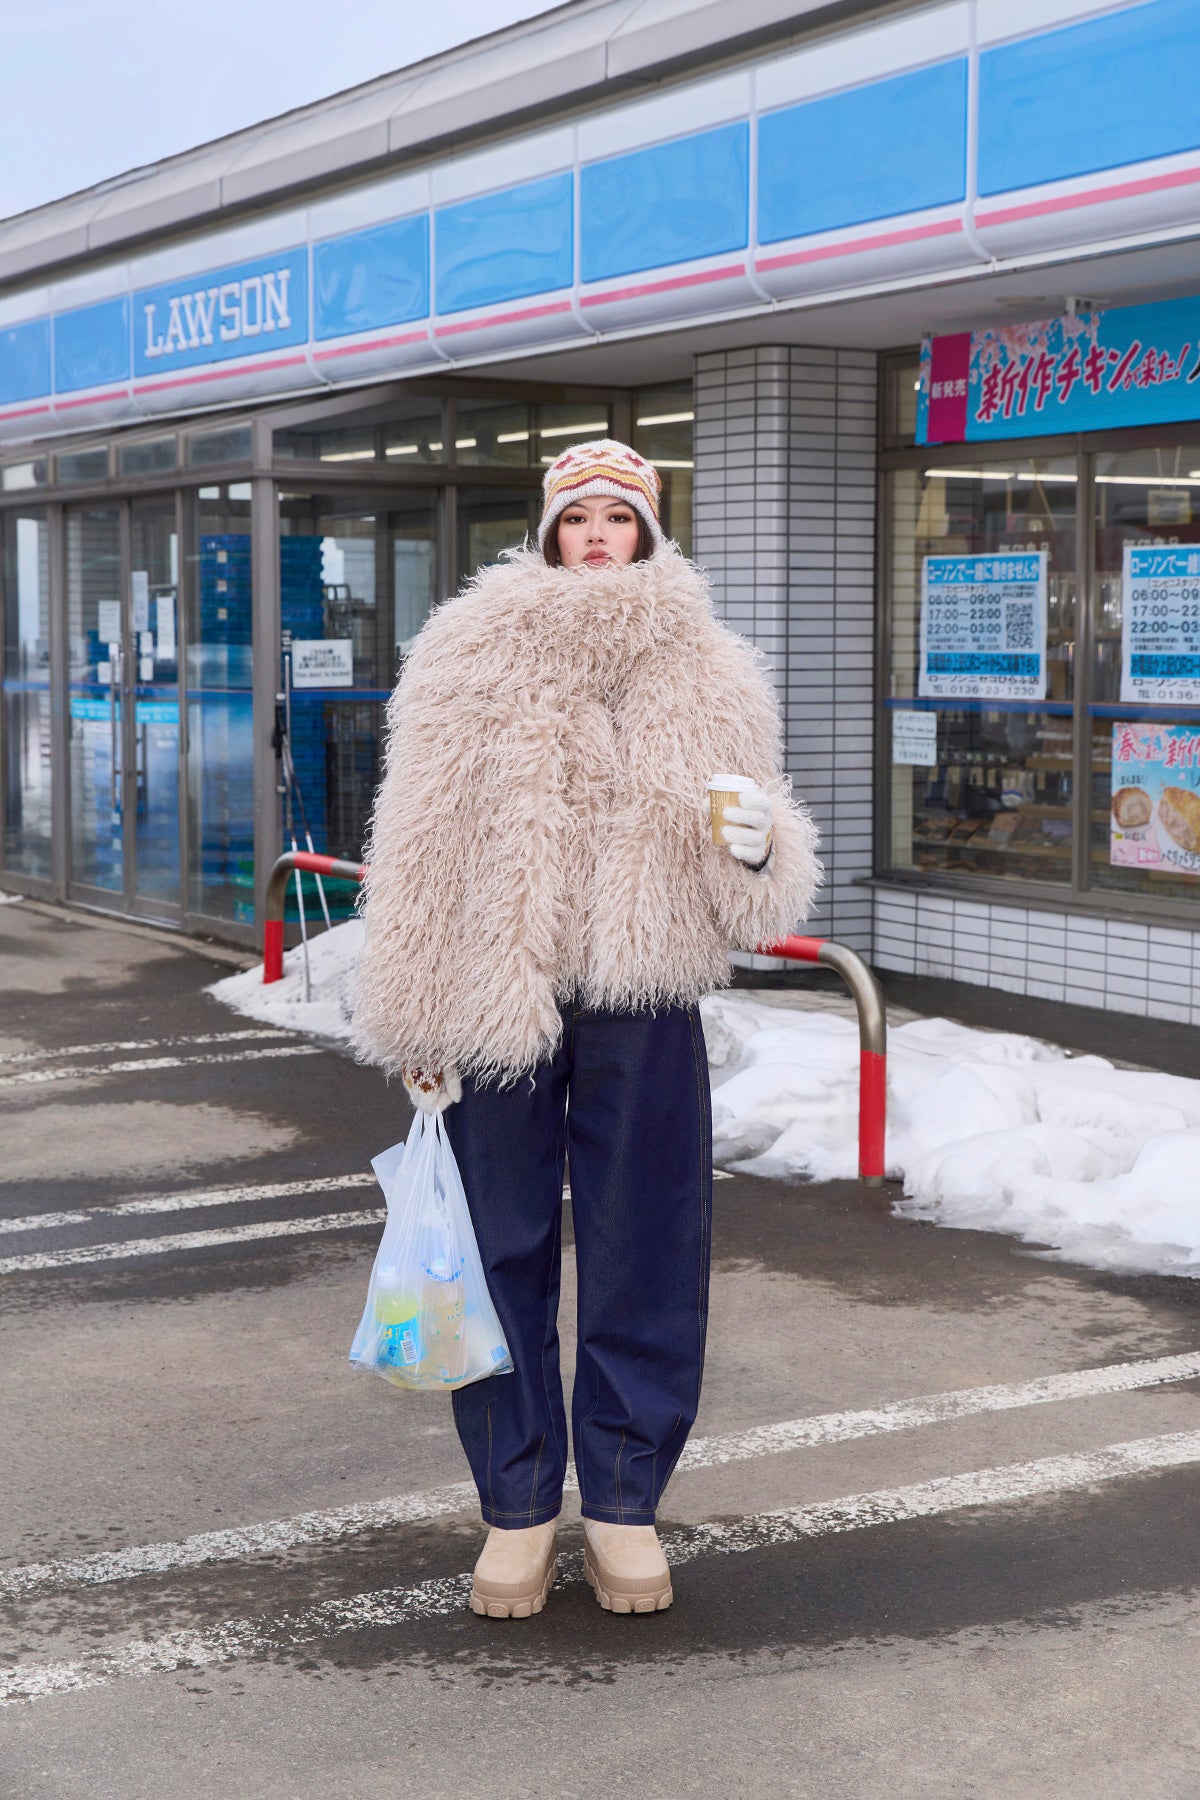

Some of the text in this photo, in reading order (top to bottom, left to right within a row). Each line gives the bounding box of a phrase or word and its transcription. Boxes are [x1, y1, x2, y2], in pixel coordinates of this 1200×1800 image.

[144, 268, 291, 358] LAWSON
[931, 378, 967, 399] 新発売
